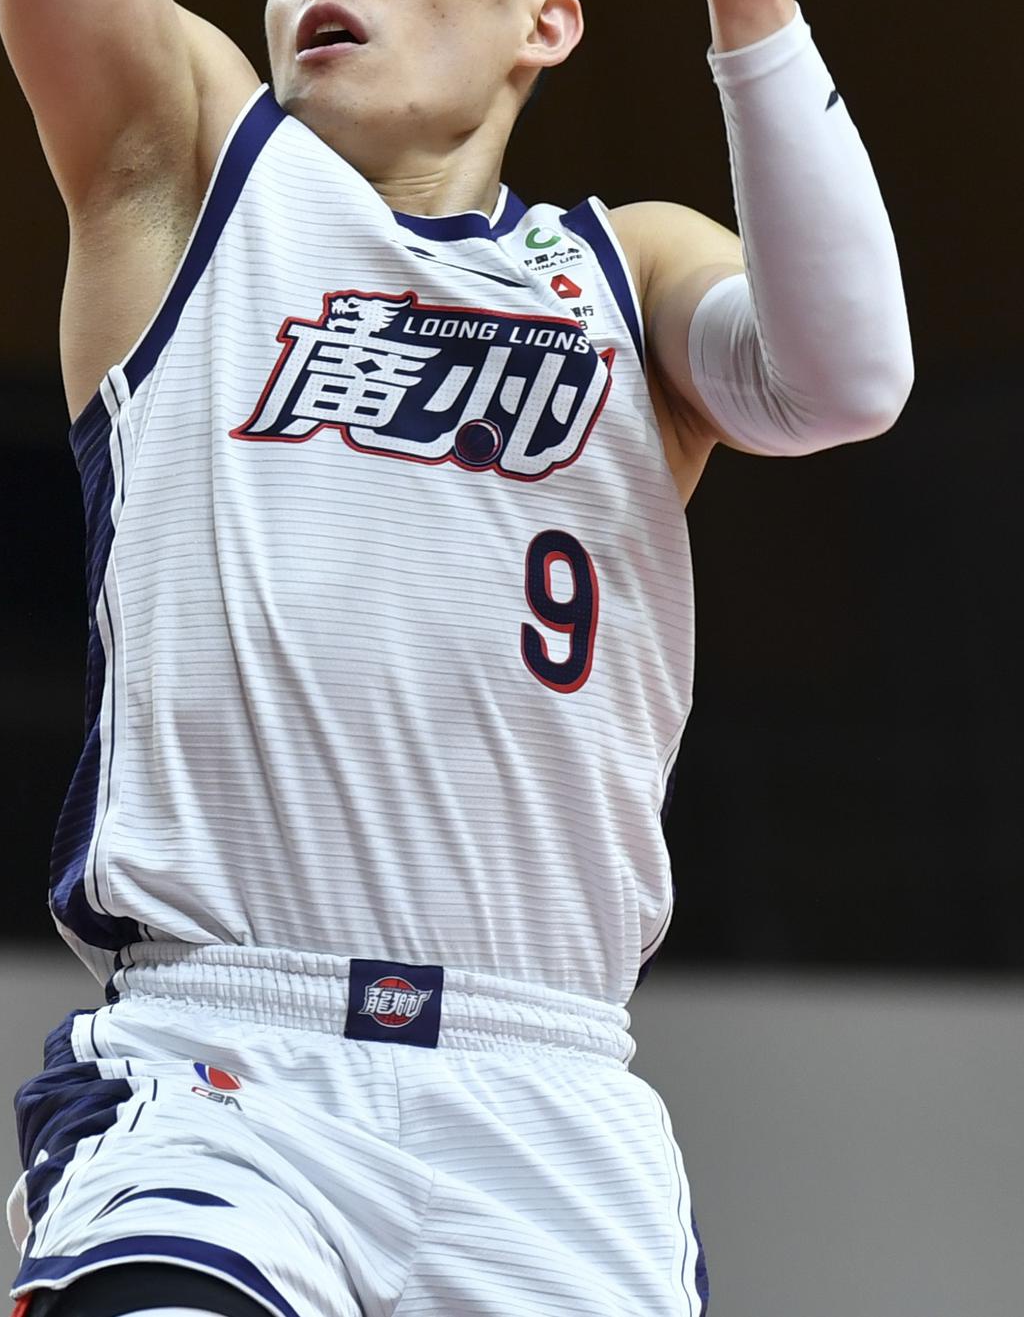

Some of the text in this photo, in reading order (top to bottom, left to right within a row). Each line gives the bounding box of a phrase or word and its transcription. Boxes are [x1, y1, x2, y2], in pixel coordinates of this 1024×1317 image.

[560, 254, 583, 264] LIFE
[402, 316, 590, 354] LOONG LIONS
[521, 529, 599, 694] 9
[191, 1086, 243, 1112] CBA
